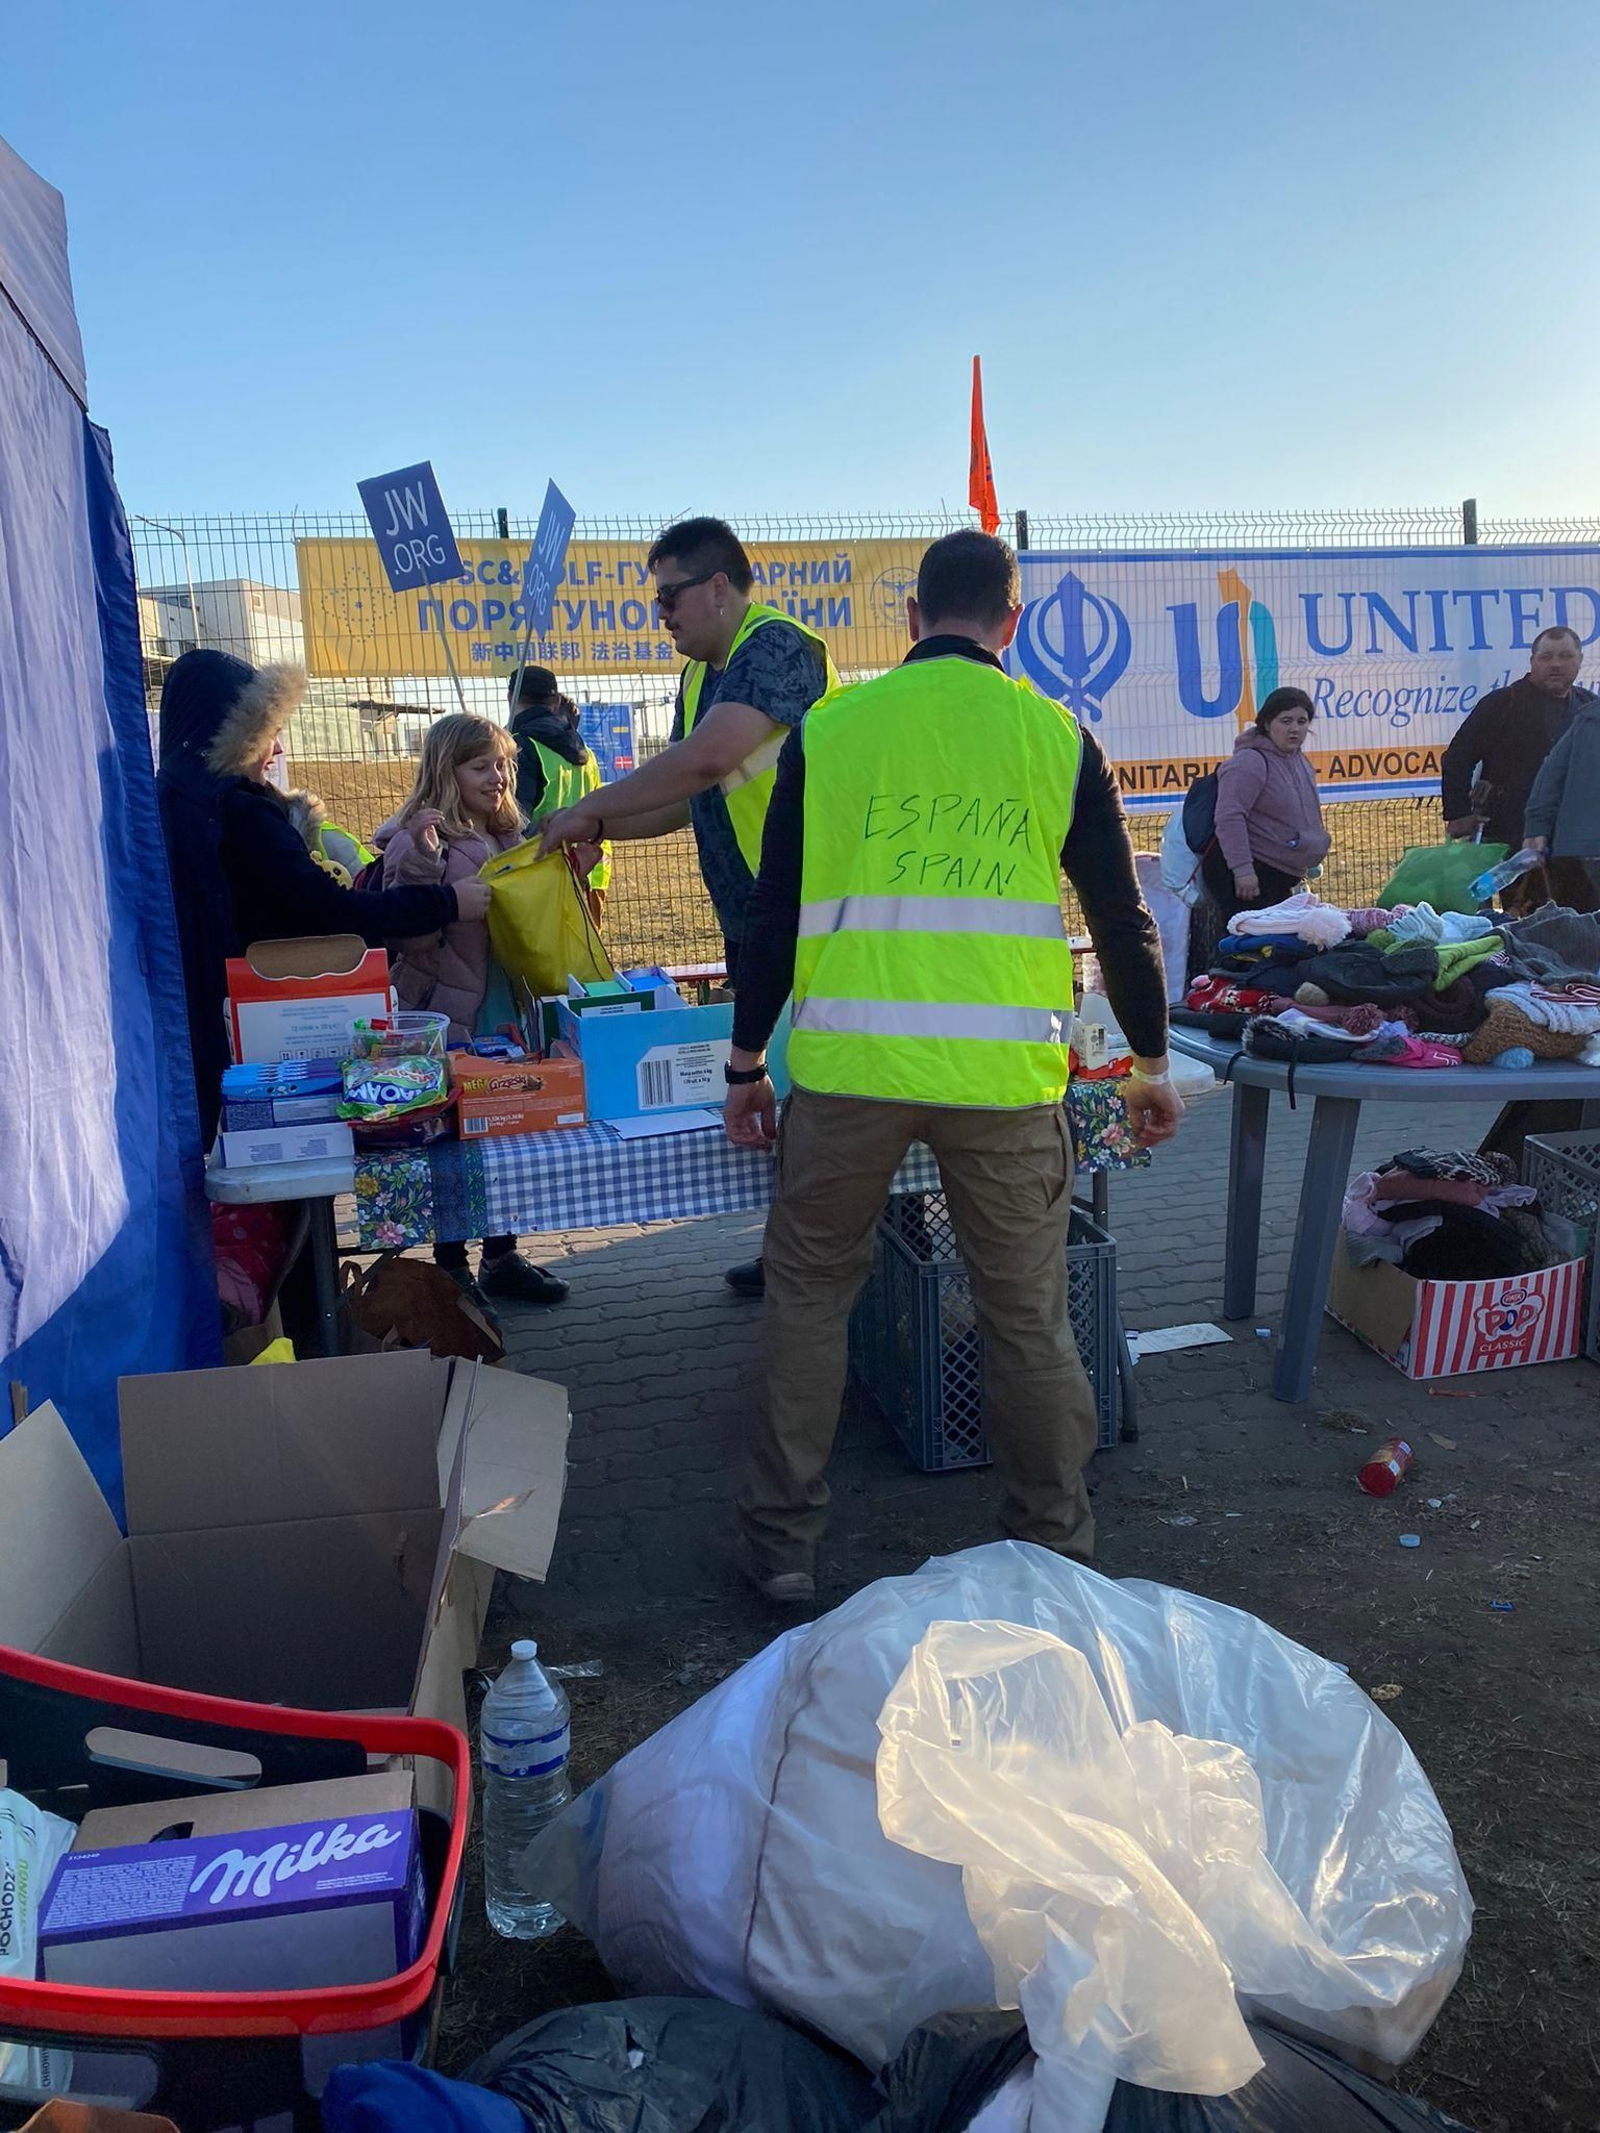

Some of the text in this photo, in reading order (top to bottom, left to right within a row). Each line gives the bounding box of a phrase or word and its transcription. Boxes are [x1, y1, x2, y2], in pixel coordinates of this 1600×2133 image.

[384, 481, 429, 536] JW
[395, 534, 447, 575] .ORG
[538, 510, 566, 571] JW
[526, 563, 550, 616] .ORG
[1312, 675, 1478, 727] Recognize
[887, 851, 1016, 896] SPAIN
[1479, 1338, 1527, 1353] CLASSIC
[1485, 1305, 1535, 1337] POP
[189, 1822, 402, 1905] Milka
